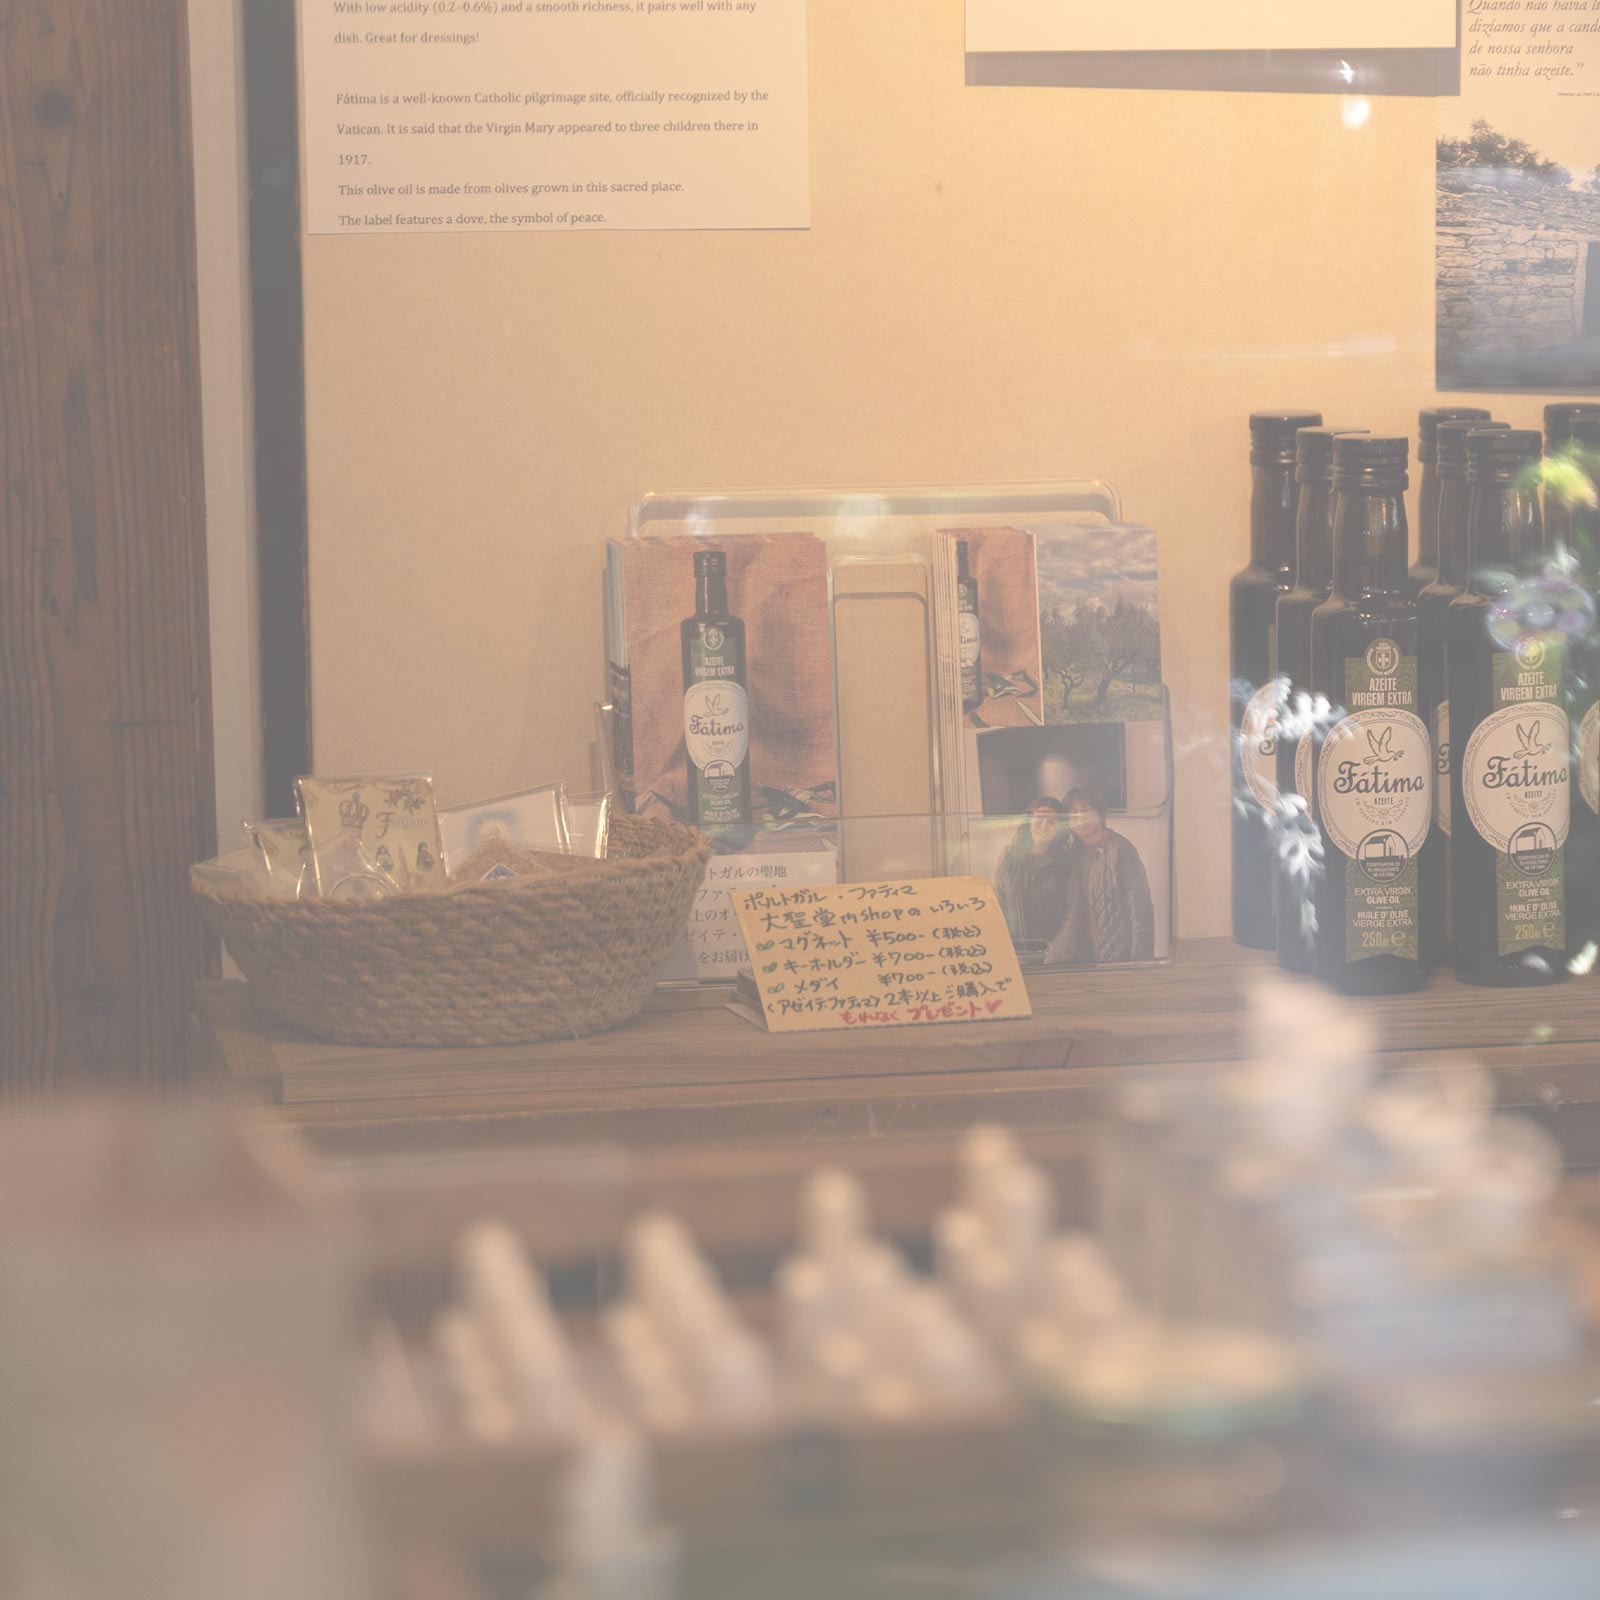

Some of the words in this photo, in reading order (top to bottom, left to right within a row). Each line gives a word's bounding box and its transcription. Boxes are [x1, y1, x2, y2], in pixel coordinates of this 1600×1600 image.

[332, 0, 363, 14] With
[364, 0, 388, 15] low
[389, 0, 430, 16] acidity
[500, 0, 524, 14] and
[525, 3, 533, 13] a
[535, 0, 580, 13] smooth
[581, 0, 634, 14] richness,
[635, 0, 646, 12] it
[646, 0, 678, 16] pairs
[678, 0, 705, 12] well
[706, 0, 733, 12] with
[735, 1, 759, 15] any
[1529, 23, 1552, 37] que
[1556, 22, 1565, 33] a
[333, 31, 362, 45] dish.
[364, 31, 398, 45] Great
[399, 31, 419, 44] for
[419, 31, 480, 47] dressings!
[1469, 40, 1483, 54] de
[1487, 45, 1521, 55] nossa
[1525, 40, 1573, 56] senhora
[1469, 62, 1492, 77] não
[1497, 61, 1530, 77] tinha
[335, 91, 377, 105] Fátima
[379, 93, 390, 105] is
[391, 95, 400, 105] a
[401, 91, 472, 105] well-known
[473, 91, 522, 104] Catholic
[523, 91, 587, 106] pilgrimage
[588, 91, 613, 105] site,
[614, 90, 666, 105] officially
[667, 88, 732, 105] recognized
[733, 89, 749, 105] by
[750, 88, 770, 102] the
[336, 123, 386, 137] Vatican.
[385, 122, 397, 137] It
[397, 123, 409, 135] is
[410, 122, 436, 135] said
[437, 122, 463, 135] that
[463, 121, 484, 134] the
[485, 121, 522, 137] Virgin
[524, 121, 556, 136] Mary
[556, 120, 613, 136] appeared
[613, 122, 628, 133] to
[628, 120, 661, 133] three
[661, 119, 712, 133] children
[713, 119, 745, 132] there
[746, 119, 759, 132] in
[337, 153, 374, 166] 1917.
[339, 183, 366, 196] This
[365, 183, 397, 198] olive
[397, 183, 414, 198] oil
[415, 183, 426, 195] is
[428, 183, 462, 195] made
[463, 182, 493, 195] from
[493, 182, 530, 195] olives
[529, 183, 570, 197] grown
[571, 181, 584, 193] in
[585, 180, 609, 193] this
[609, 180, 649, 193] sacred
[650, 180, 685, 197] place.
[337, 214, 363, 227] The
[363, 213, 393, 226] label
[395, 213, 445, 226] features
[445, 215, 454, 225] a
[454, 212, 489, 225] dove,
[489, 212, 510, 225] the
[510, 211, 555, 227] symbol
[554, 211, 570, 225] of
[569, 213, 608, 228] peace.
[1369, 678, 1397, 691] AZEITE
[1518, 672, 1544, 685] AZEITE
[1352, 692, 1384, 706] VIRGEM
[1387, 691, 1412, 705] EXTRA
[1500, 687, 1533, 701] VIRGEM
[1535, 684, 1557, 699] EXTRA
[690, 714, 744, 736] Fátima
[1333, 760, 1424, 794] Fátima
[1482, 756, 1568, 789] Fátima
[1353, 887, 1383, 897] EXTRA
[1384, 886, 1412, 896] VIRGIN
[1366, 896, 1388, 905] OLIVE
[1389, 896, 1401, 904] OIL
[1353, 918, 1385, 928] VIERGE
[1386, 917, 1413, 928] EXTRA
[1357, 910, 1380, 920] HUILE
[1390, 909, 1409, 919] OLIVE
[779, 930, 853, 951] マグネット
[784, 951, 866, 974] キーホルダー
[794, 976, 839, 994] メダイ
